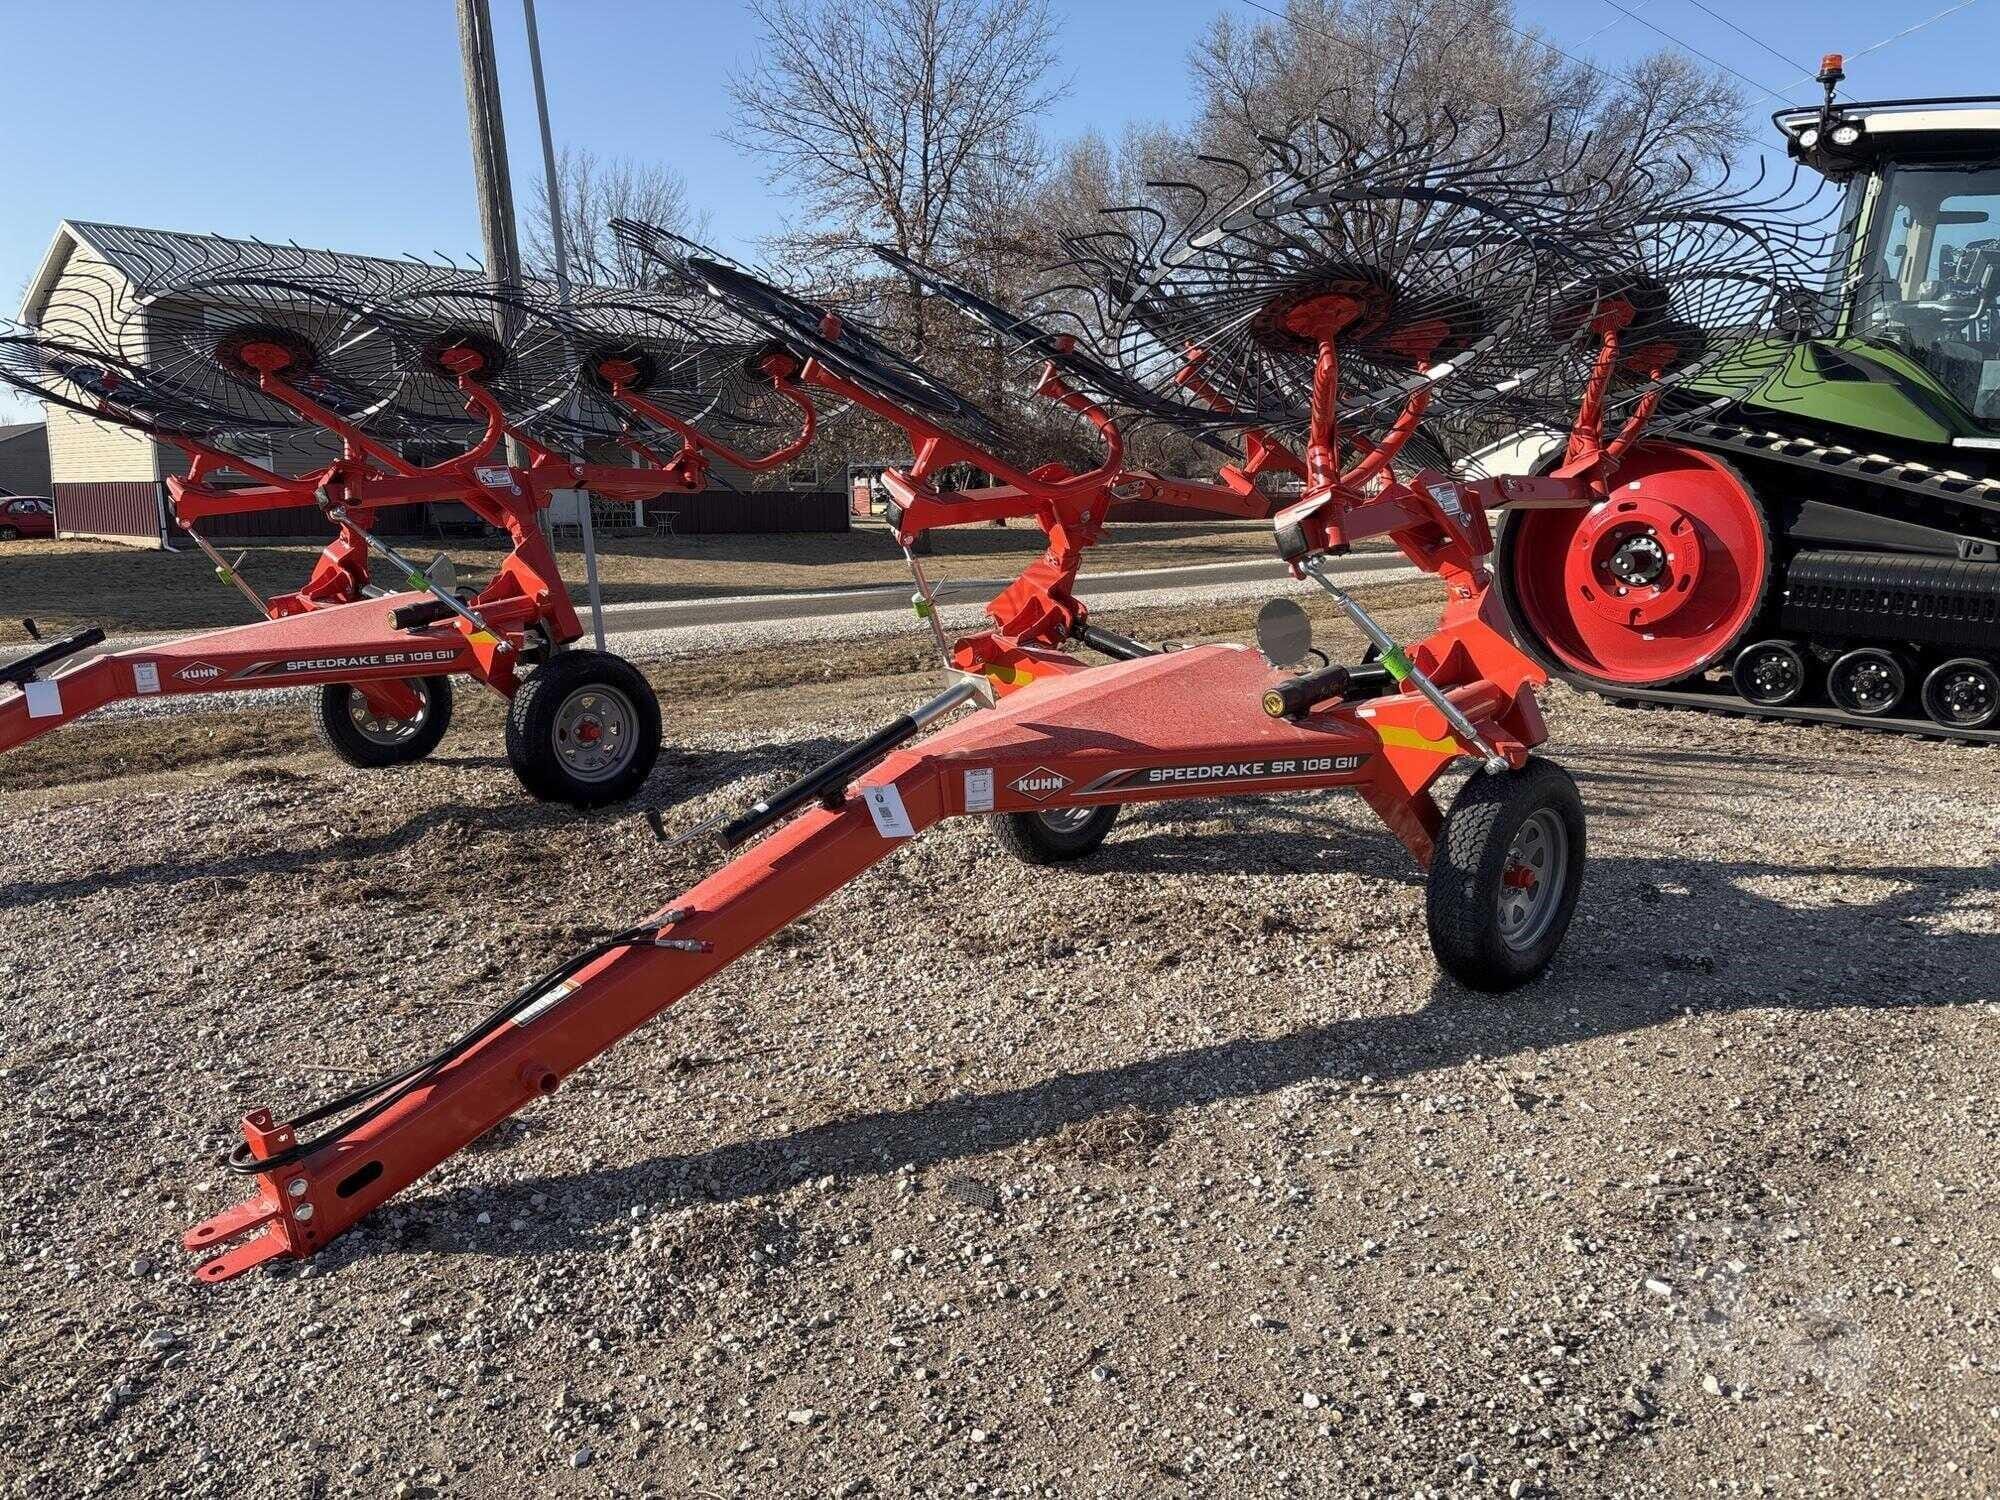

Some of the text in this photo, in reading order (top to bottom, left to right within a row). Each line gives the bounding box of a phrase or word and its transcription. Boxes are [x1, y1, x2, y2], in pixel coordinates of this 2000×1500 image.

[286, 656, 380, 671] SPEEDRAKE
[385, 653, 405, 663] SR
[409, 652, 433, 661] 108
[182, 668, 218, 679] KUHN
[1149, 756, 1358, 782] SPEEDRAKE SR 108 GII
[1018, 778, 1063, 791] KUHN
